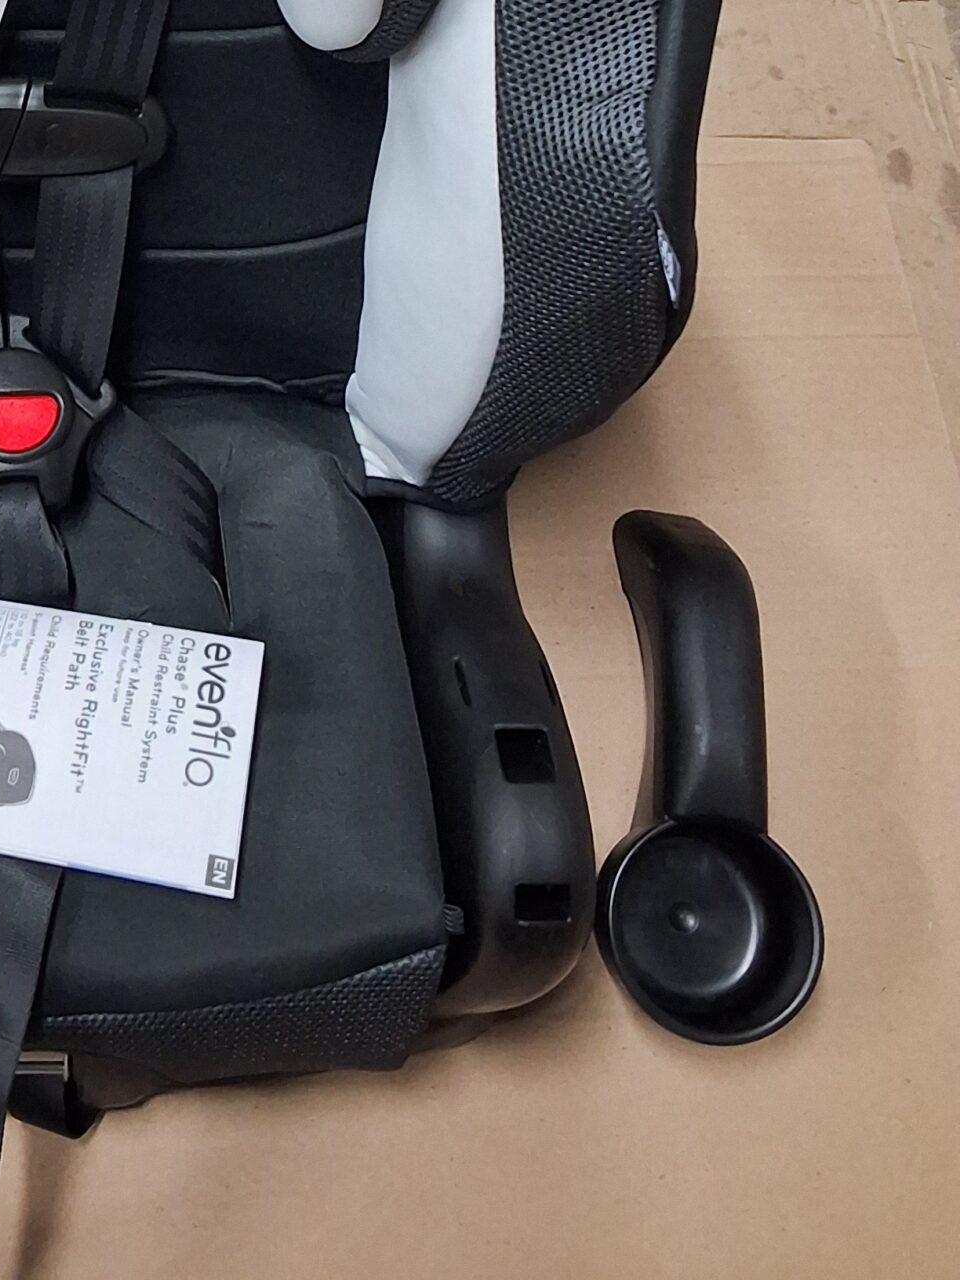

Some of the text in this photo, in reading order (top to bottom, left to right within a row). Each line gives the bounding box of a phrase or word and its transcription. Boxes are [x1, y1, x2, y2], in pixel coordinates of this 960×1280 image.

[27, 614, 61, 721] Child Requirements
[63, 619, 93, 692] Belt Path
[84, 622, 114, 693] Exclusive
[119, 628, 150, 728] Owner's Manual
[134, 632, 174, 784] Child Restraint System
[164, 694, 186, 736] Plus
[185, 641, 237, 788] evenflo
[211, 857, 229, 885] EN
